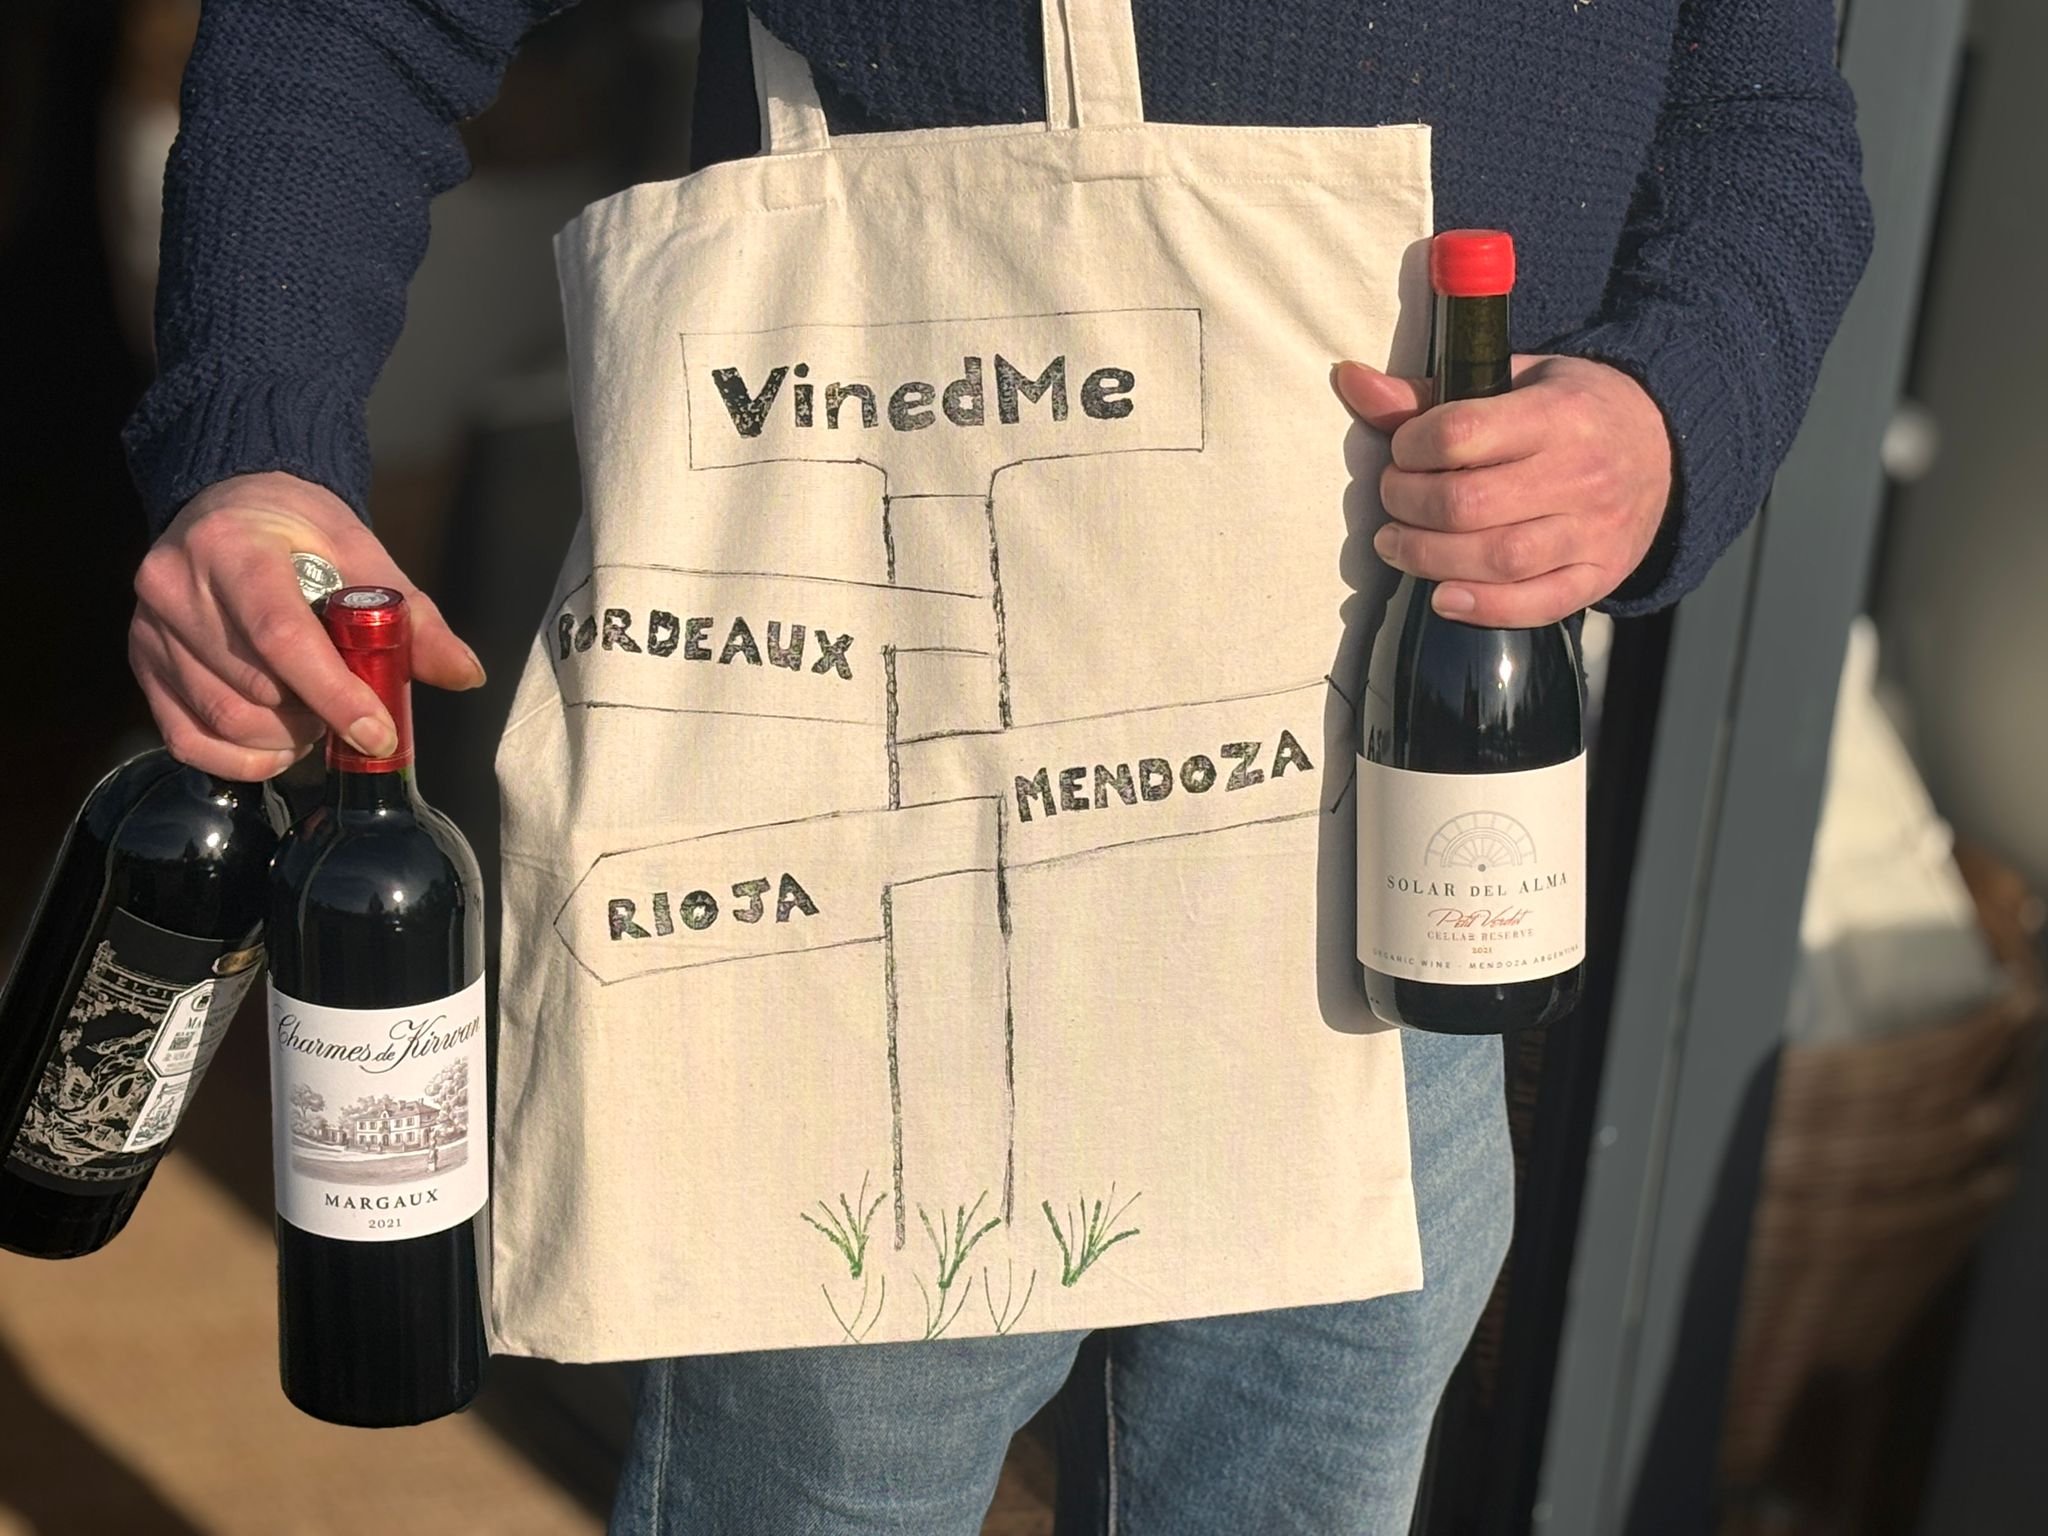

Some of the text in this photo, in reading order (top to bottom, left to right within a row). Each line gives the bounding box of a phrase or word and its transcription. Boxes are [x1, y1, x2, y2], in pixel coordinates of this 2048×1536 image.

[712, 353, 1135, 437] VinedMe
[1014, 729, 1314, 823] MENDOZA
[1386, 871, 1568, 898] SOLAR DEL ALMA
[608, 872, 820, 941] RIOJA
[1481, 928, 1535, 942] RESERVE
[1421, 960, 1451, 969] WINE
[1469, 959, 1528, 969] MENDOZA
[274, 1003, 480, 1074] Charmes de Kirwan
[324, 1188, 439, 1210] MARGAUX
[368, 1218, 401, 1229] 2021
